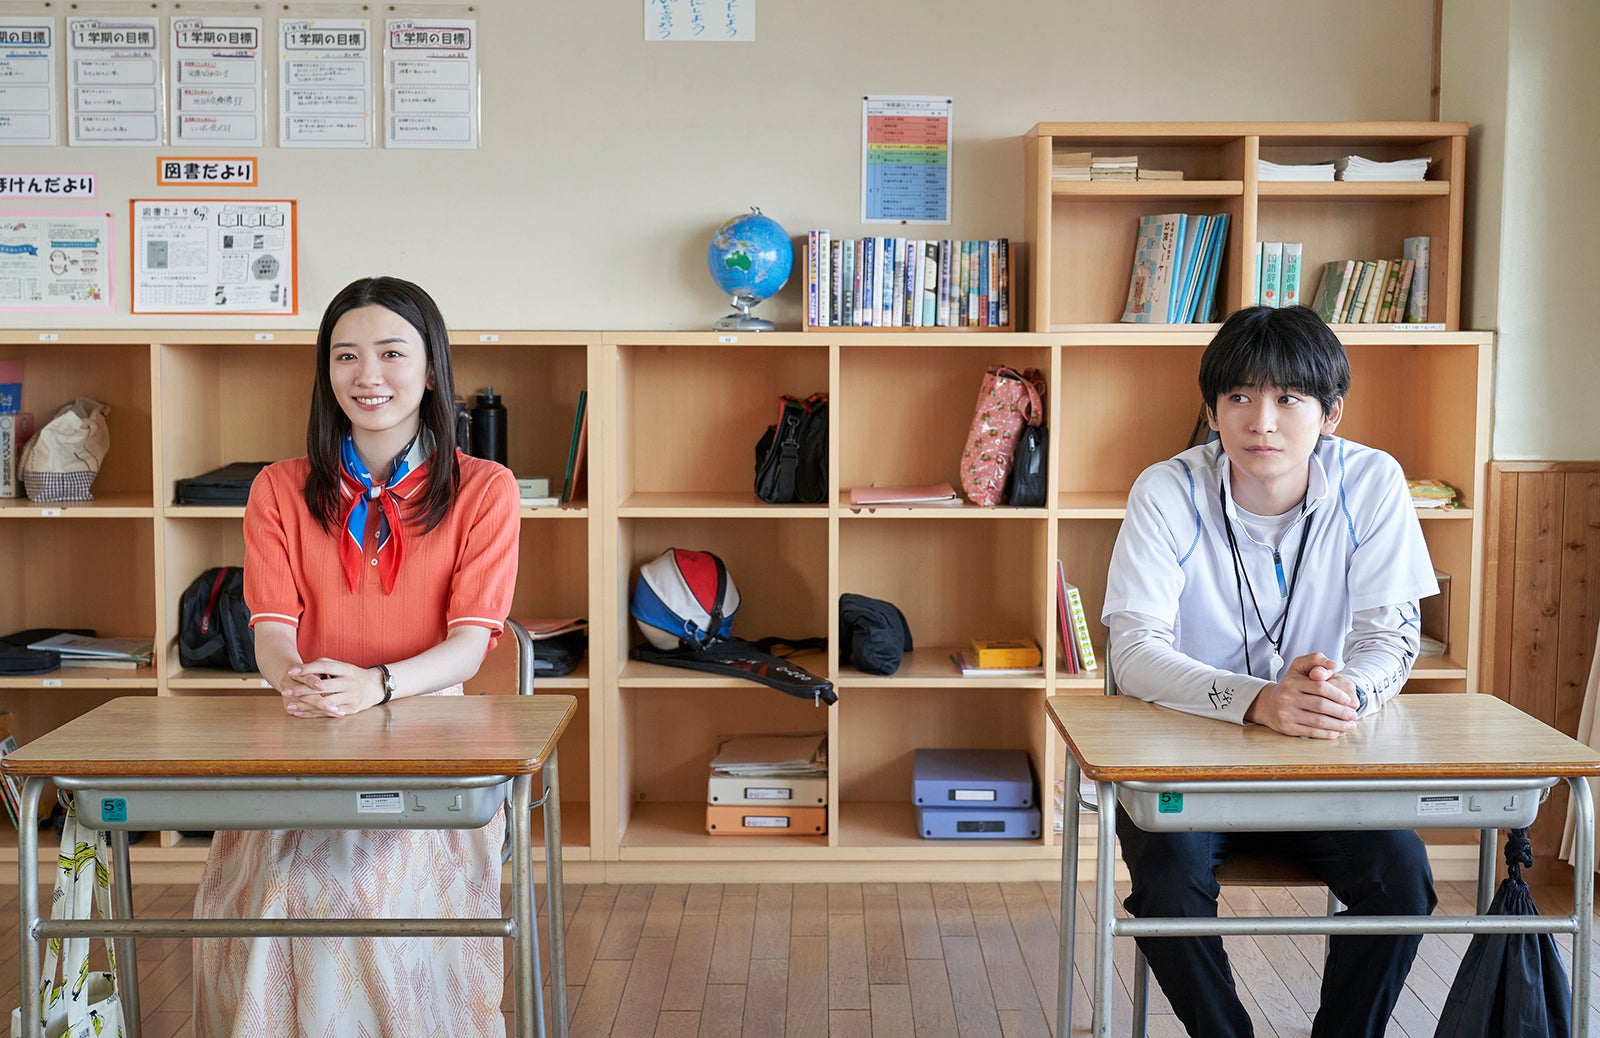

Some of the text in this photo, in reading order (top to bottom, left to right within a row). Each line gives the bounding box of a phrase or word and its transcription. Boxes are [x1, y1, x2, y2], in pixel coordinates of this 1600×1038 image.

[78, 31, 151, 44] 1学期の目標
[183, 32, 253, 44] 1学期の目標
[290, 33, 361, 46] 1学期の目標
[395, 32, 466, 45] 1学期の目標
[164, 162, 251, 180] 図書だより
[142, 207, 189, 217] 図書だより
[1266, 254, 1277, 290] 国語辞典
[1287, 254, 1297, 290] 国語辞典
[104, 800, 114, 811] 5
